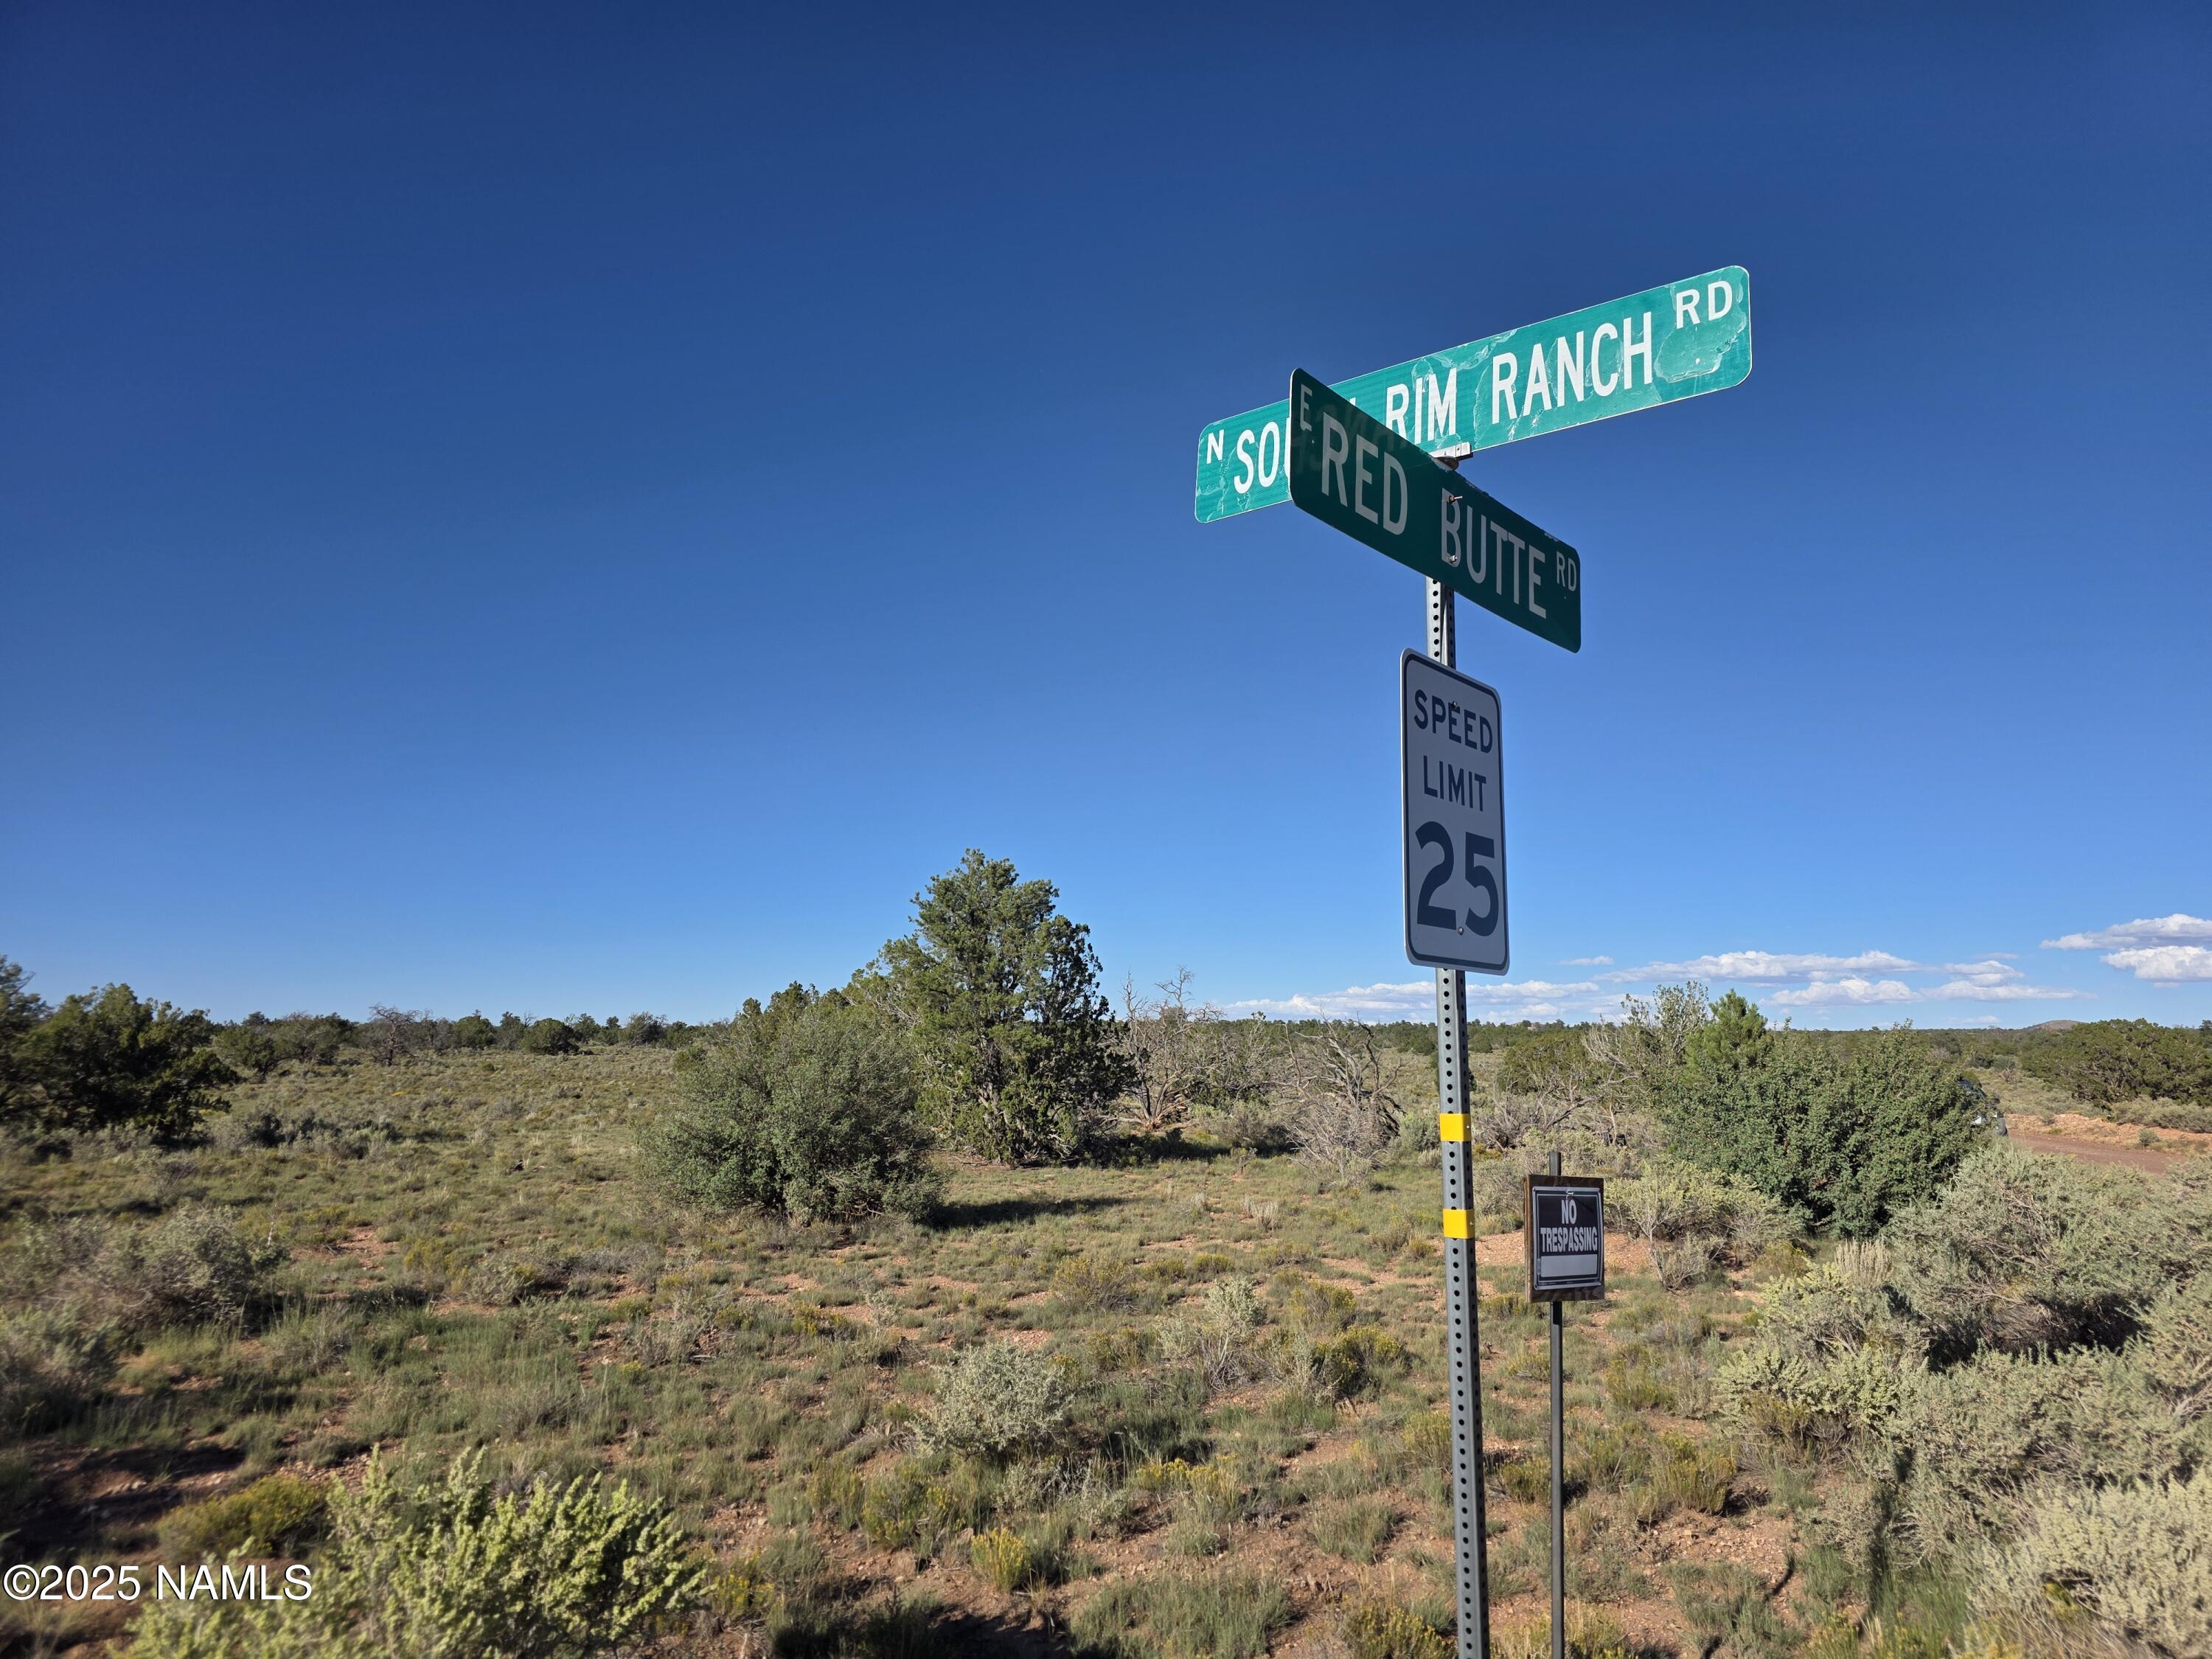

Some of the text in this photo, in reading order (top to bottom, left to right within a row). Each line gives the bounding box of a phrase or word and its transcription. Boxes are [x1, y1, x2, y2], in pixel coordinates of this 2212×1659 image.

[1206, 429, 1225, 465] N
[1385, 367, 1457, 445] RIM
[1492, 310, 1653, 425] RANCH
[1675, 279, 1733, 330] RD
[1299, 383, 1313, 432] E
[1321, 411, 1408, 536] RED
[1441, 487, 1547, 620] BUTTE
[1556, 550, 1577, 592] RD
[1413, 689, 1493, 754] SPEED
[1422, 755, 1487, 812] LIMIT
[1414, 820, 1500, 937] 25
[1540, 1226, 1598, 1252] TRESPASSING
[1561, 1199, 1577, 1225] NO
